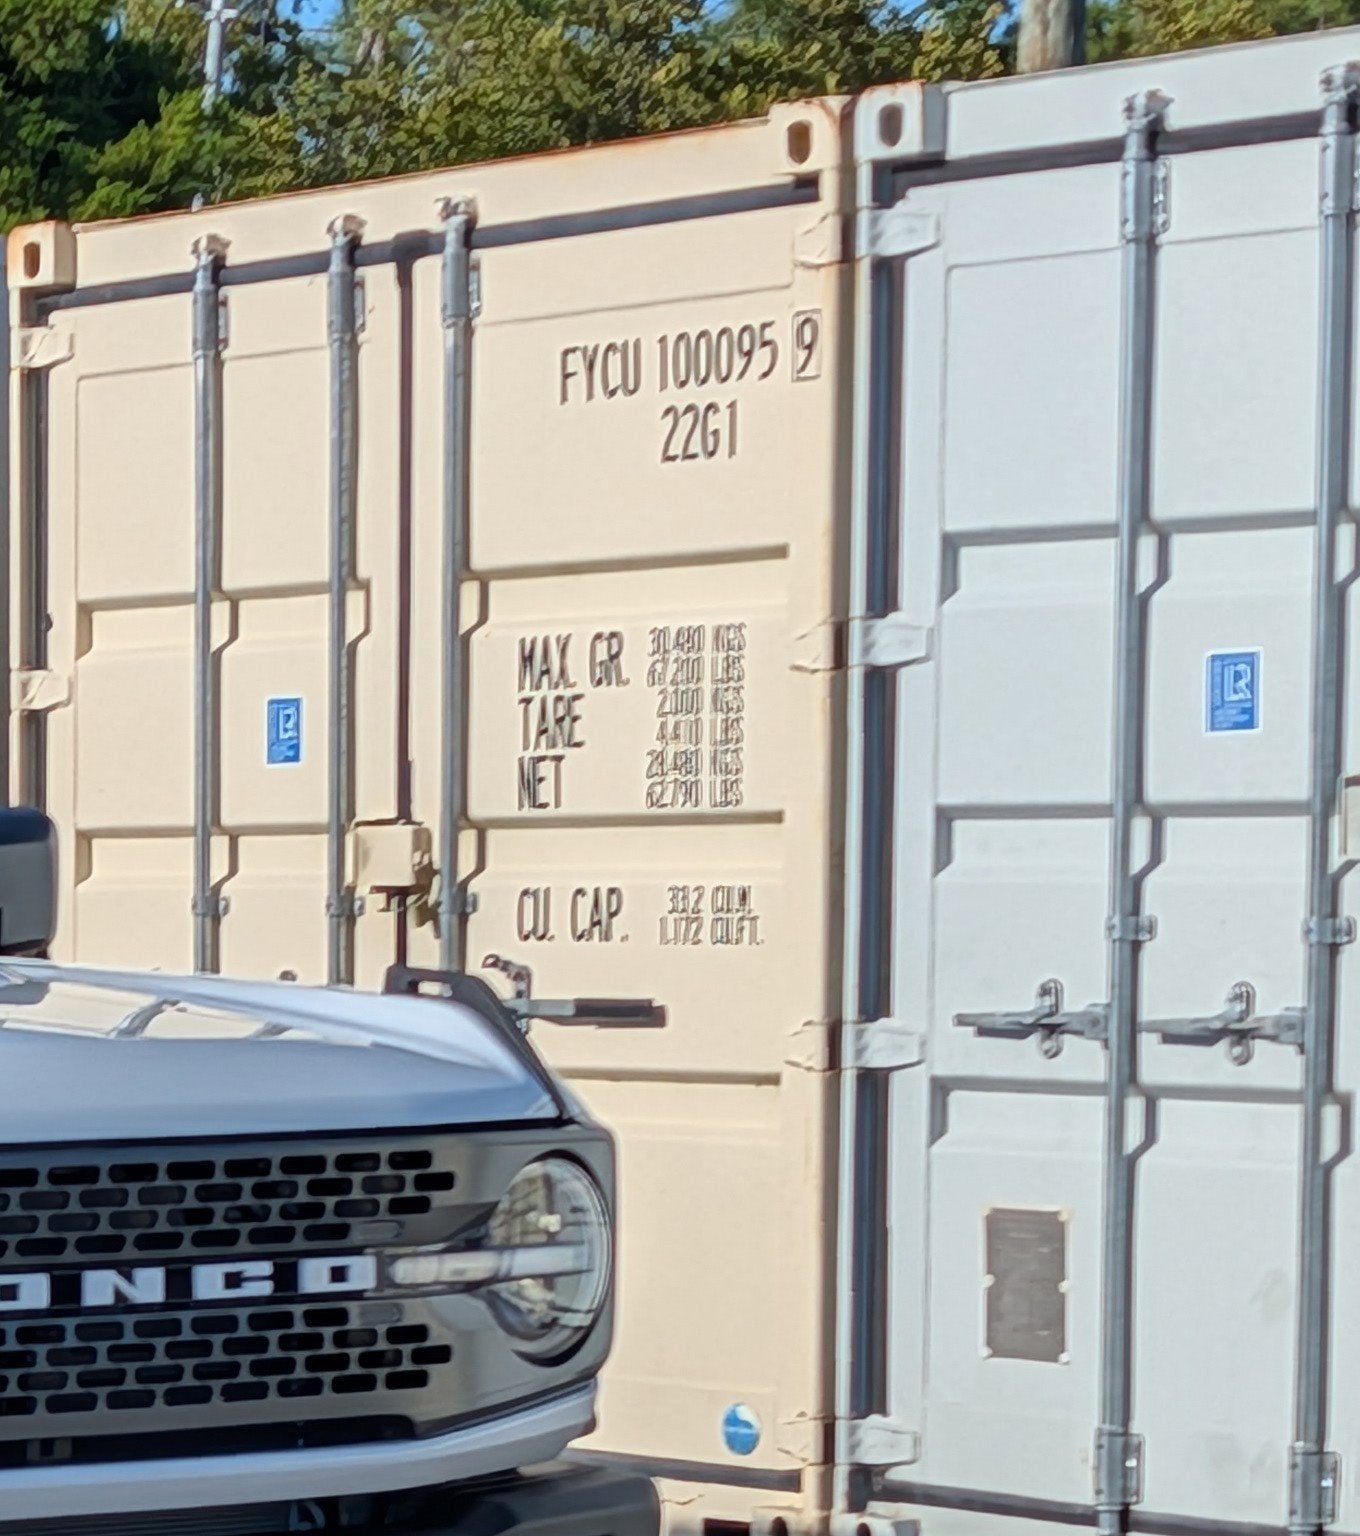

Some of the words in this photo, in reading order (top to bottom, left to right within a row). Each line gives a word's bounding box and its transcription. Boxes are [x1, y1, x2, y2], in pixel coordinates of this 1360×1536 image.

[560, 337, 641, 405] FYCU
[657, 320, 779, 392] 100095
[796, 317, 819, 375] 9
[661, 399, 737, 463] 22G1
[518, 633, 577, 693] MAX.
[518, 693, 585, 751] TARE
[518, 755, 565, 811] NET
[570, 886, 628, 942] CAP.
